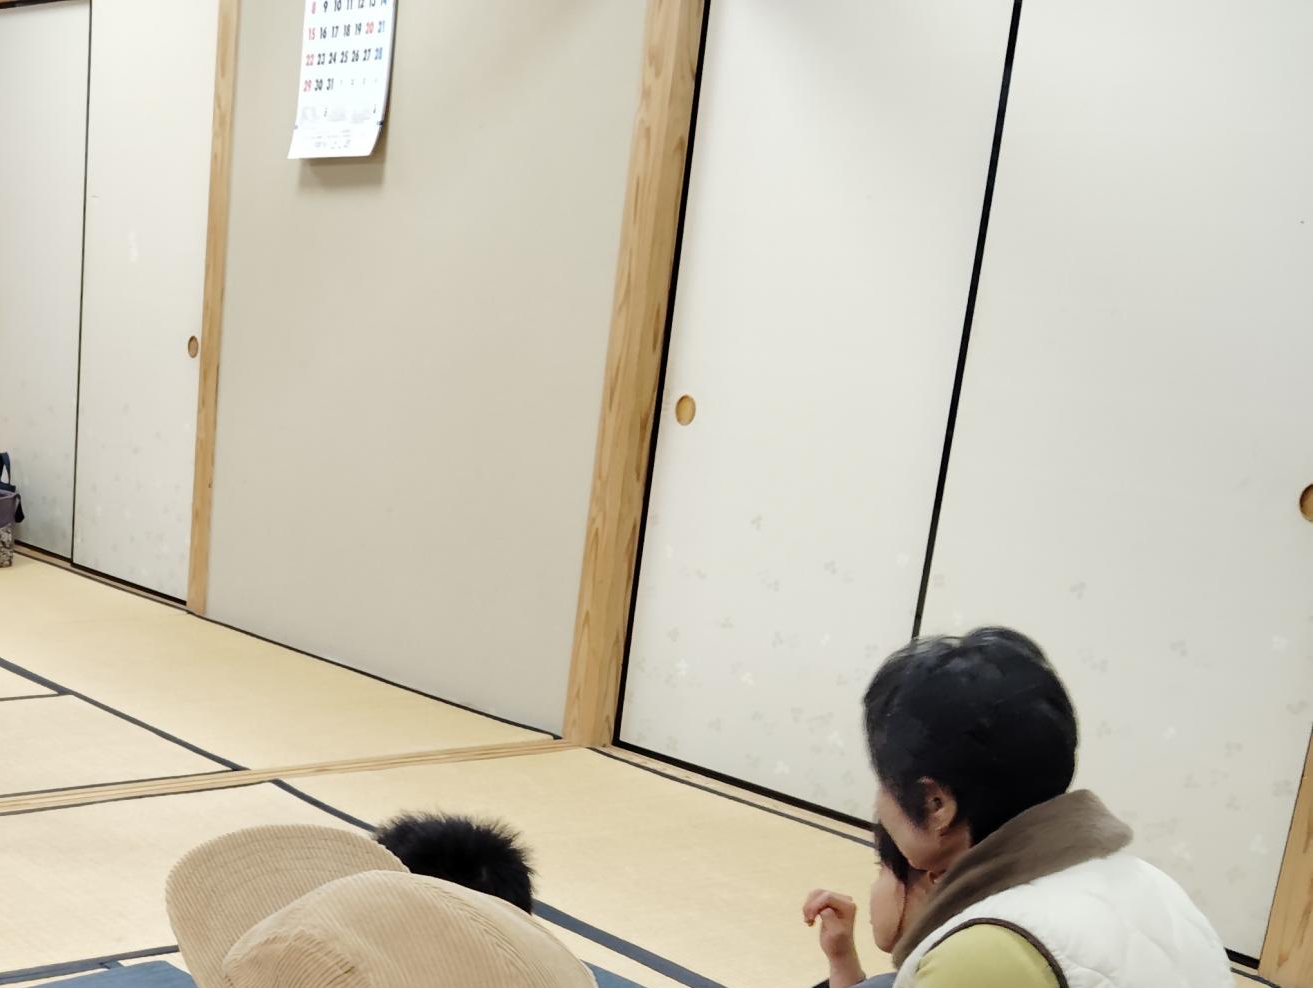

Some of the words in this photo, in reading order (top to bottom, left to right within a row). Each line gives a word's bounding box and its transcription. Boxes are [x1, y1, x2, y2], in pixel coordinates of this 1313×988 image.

[311, 1, 317, 14] 8
[323, 0, 329, 13] 9
[333, 0, 342, 12] 10
[346, 0, 353, 10] 11
[308, 27, 316, 40] 15
[320, 26, 327, 40] 16
[332, 25, 339, 38] 17
[343, 24, 351, 37] 18
[355, 22, 362, 36] 19
[365, 21, 374, 34] 20
[377, 20, 385, 34] 21
[305, 53, 314, 66] 22
[317, 52, 326, 66] 23
[328, 51, 337, 64] 24
[340, 50, 349, 64] 25
[351, 49, 359, 62] 26
[363, 48, 371, 62] 27
[374, 47, 383, 61] 28
[303, 79, 312, 92] 29
[314, 79, 323, 91] 30
[326, 78, 334, 91] 31
